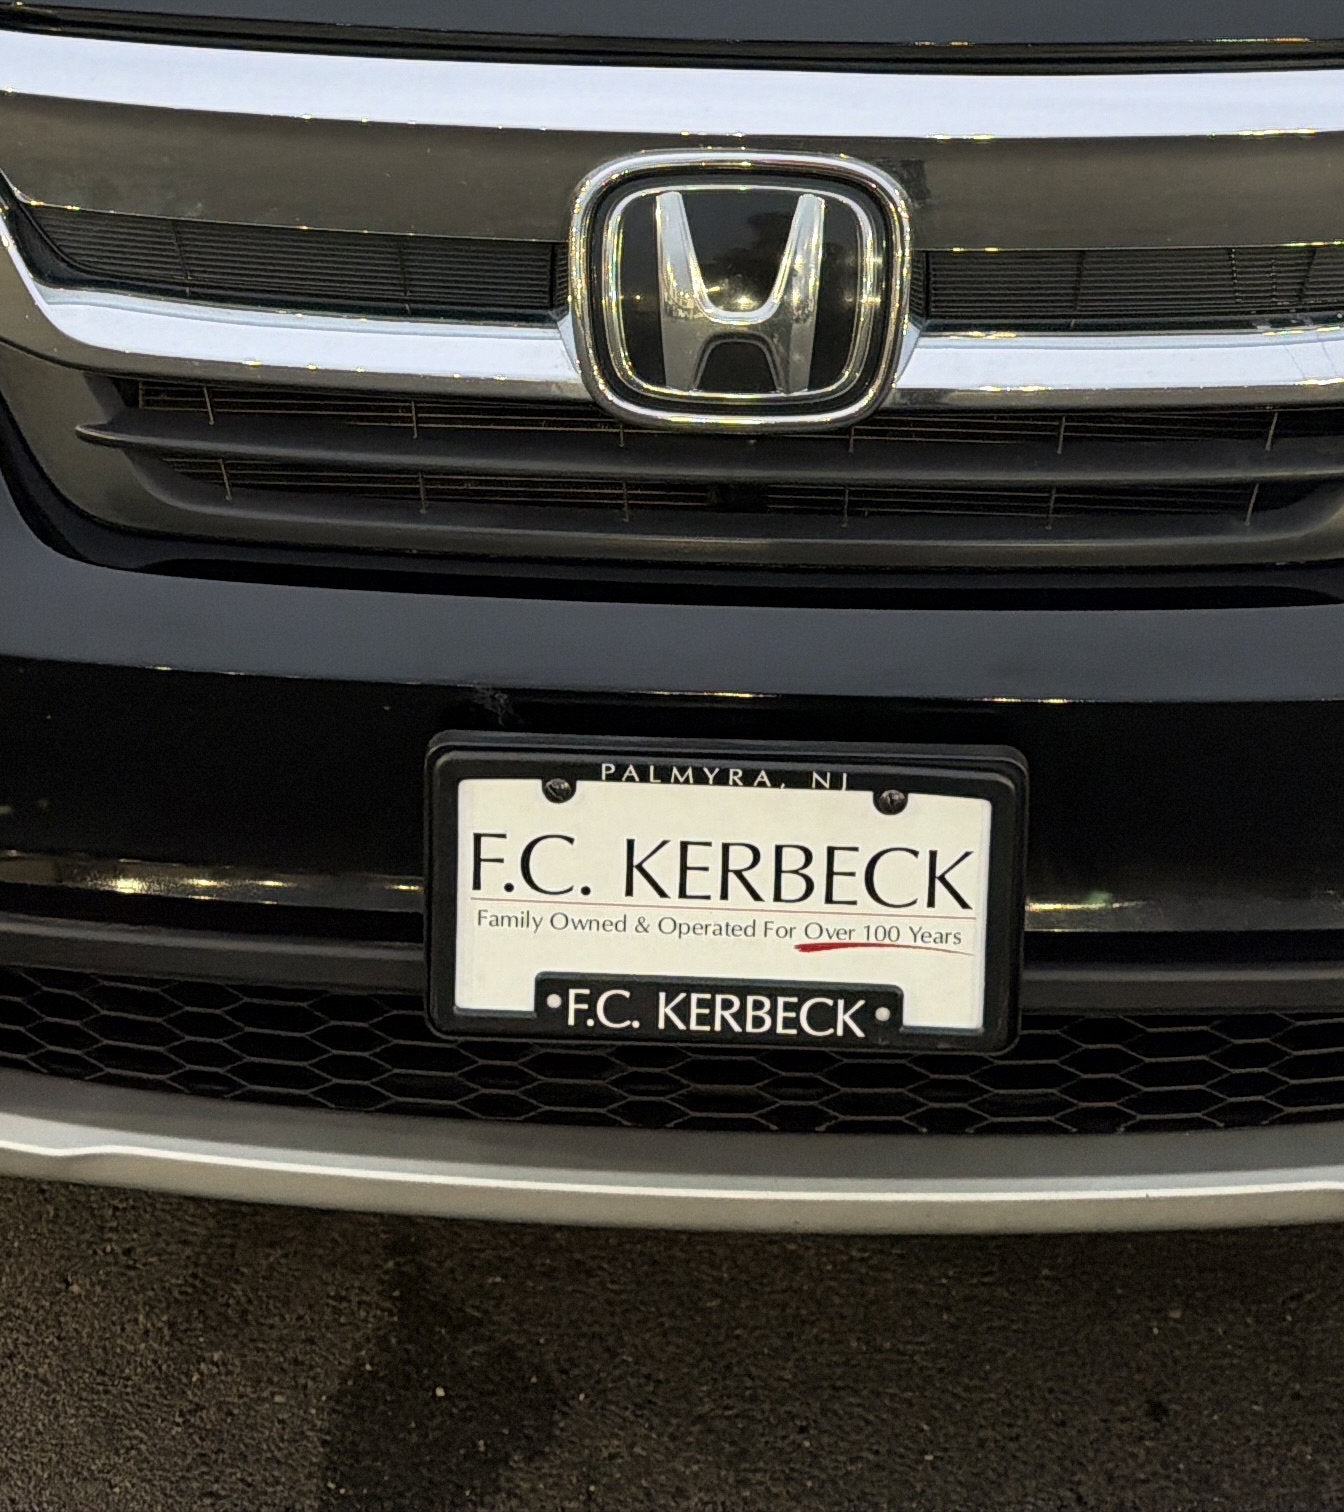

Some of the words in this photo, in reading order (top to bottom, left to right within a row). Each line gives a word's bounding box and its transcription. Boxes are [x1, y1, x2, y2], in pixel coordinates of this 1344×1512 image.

[601, 763, 786, 790] PALMYRA,
[471, 832, 591, 896] F.C.
[624, 838, 974, 910] KERBECK
[477, 909, 543, 934] Family
[550, 913, 628, 935] Owned
[634, 916, 650, 934] &
[657, 916, 756, 943] Operated
[763, 921, 796, 939] For
[803, 922, 856, 942] Over
[863, 924, 901, 943] 100
[908, 925, 962, 945] Years
[567, 988, 640, 1029] F.C.
[657, 992, 865, 1038] KERBECK
